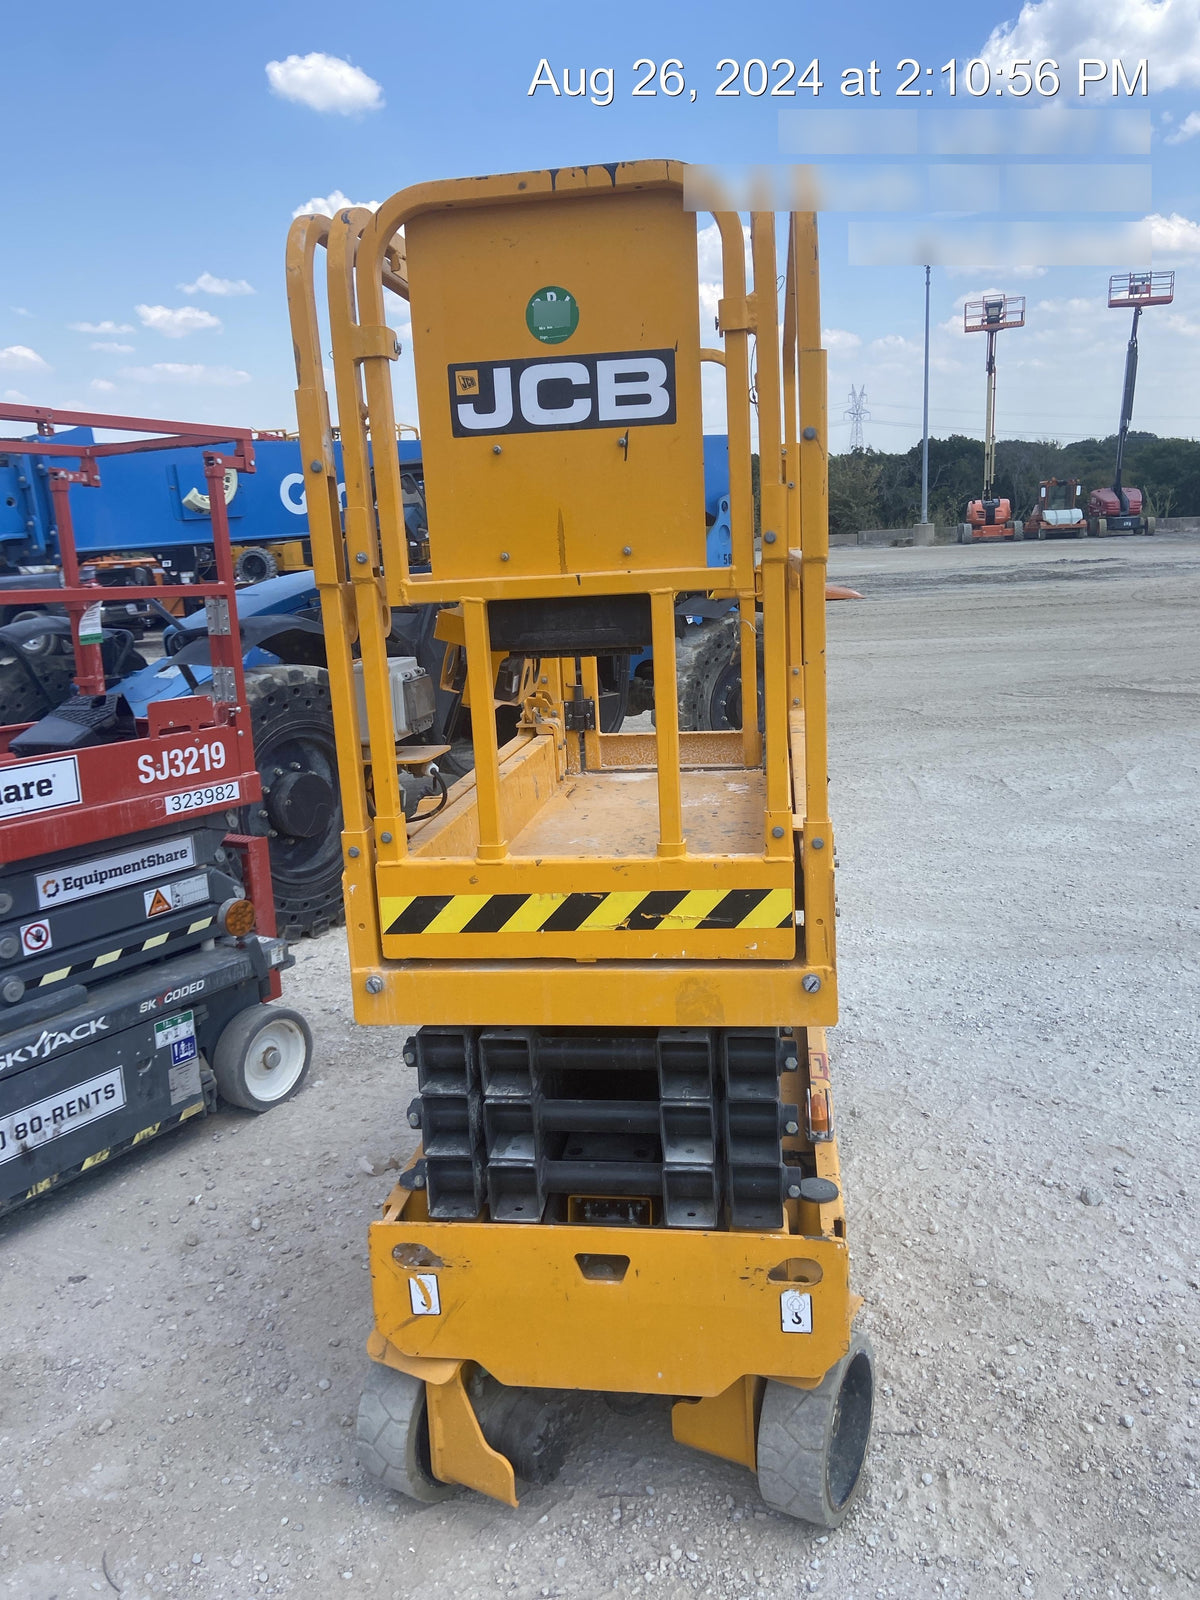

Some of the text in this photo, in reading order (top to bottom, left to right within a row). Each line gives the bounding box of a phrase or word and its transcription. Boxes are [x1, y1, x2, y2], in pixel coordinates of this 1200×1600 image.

[457, 357, 670, 430] JCB
[137, 741, 226, 784] SJ3219
[170, 783, 236, 812] 323982
[62, 848, 188, 892] EquipmentShare
[139, 979, 206, 1013] SKYCODED
[14, 1083, 116, 1141] 80-RENTS
